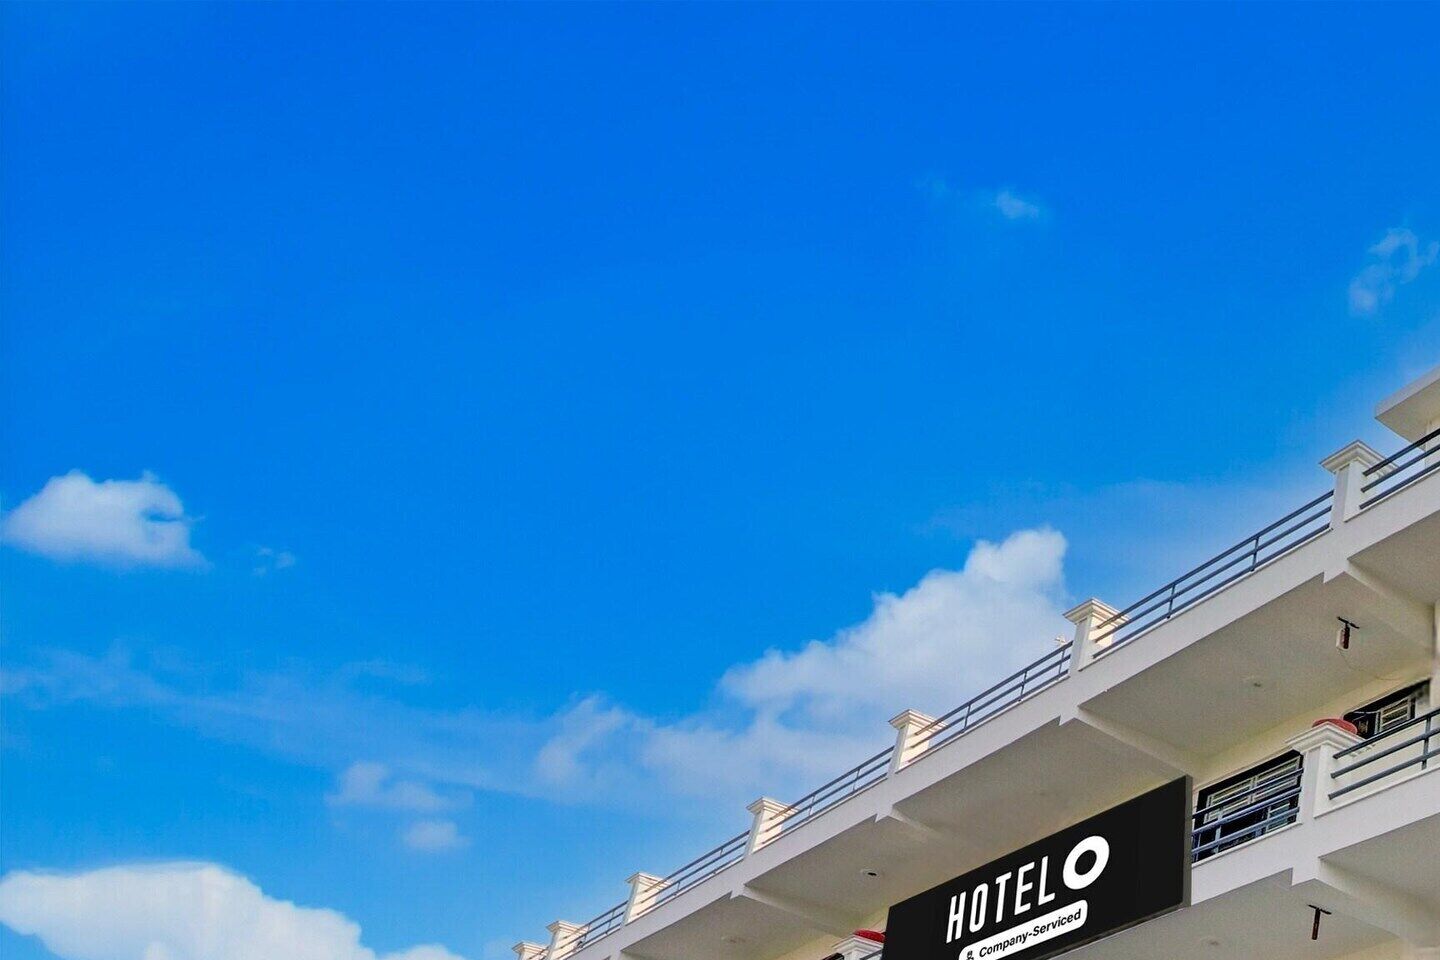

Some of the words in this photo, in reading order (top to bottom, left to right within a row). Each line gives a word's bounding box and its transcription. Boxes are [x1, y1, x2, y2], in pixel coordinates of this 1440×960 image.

[946, 855, 1056, 944] HOTEL
[1062, 835, 1110, 890] O
[978, 908, 1083, 958] Company-Serviced
